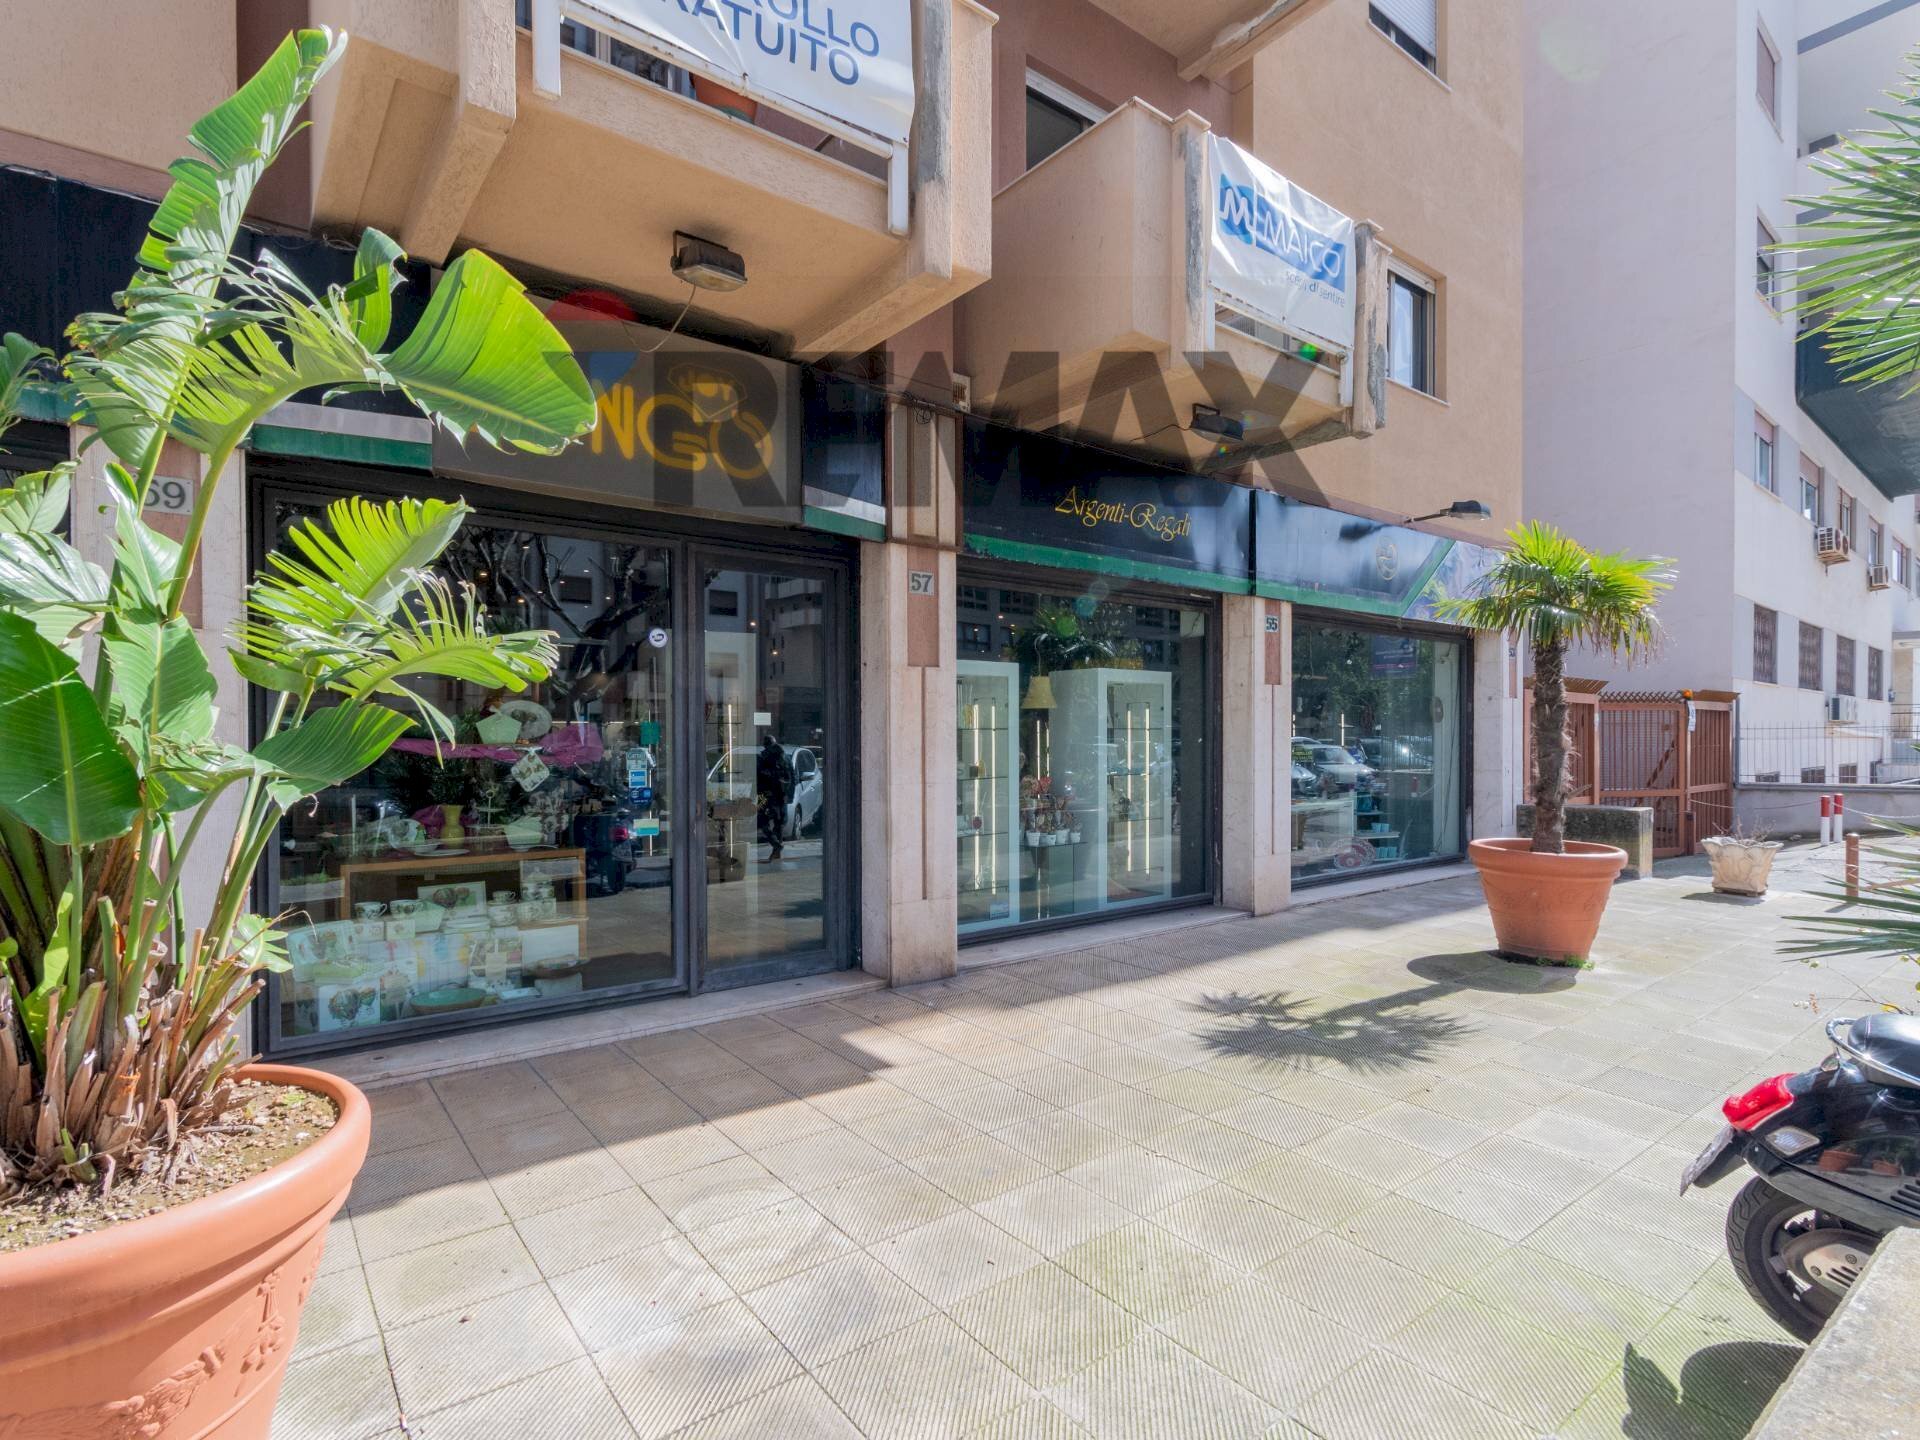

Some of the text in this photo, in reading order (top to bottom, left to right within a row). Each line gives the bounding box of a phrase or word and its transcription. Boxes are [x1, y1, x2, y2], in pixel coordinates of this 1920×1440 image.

[677, 0, 859, 86] ATUITO
[754, 0, 880, 57] OLLO
[1263, 210, 1342, 279] MAICO
[911, 572, 933, 593] 57
[1266, 616, 1279, 631] 55
